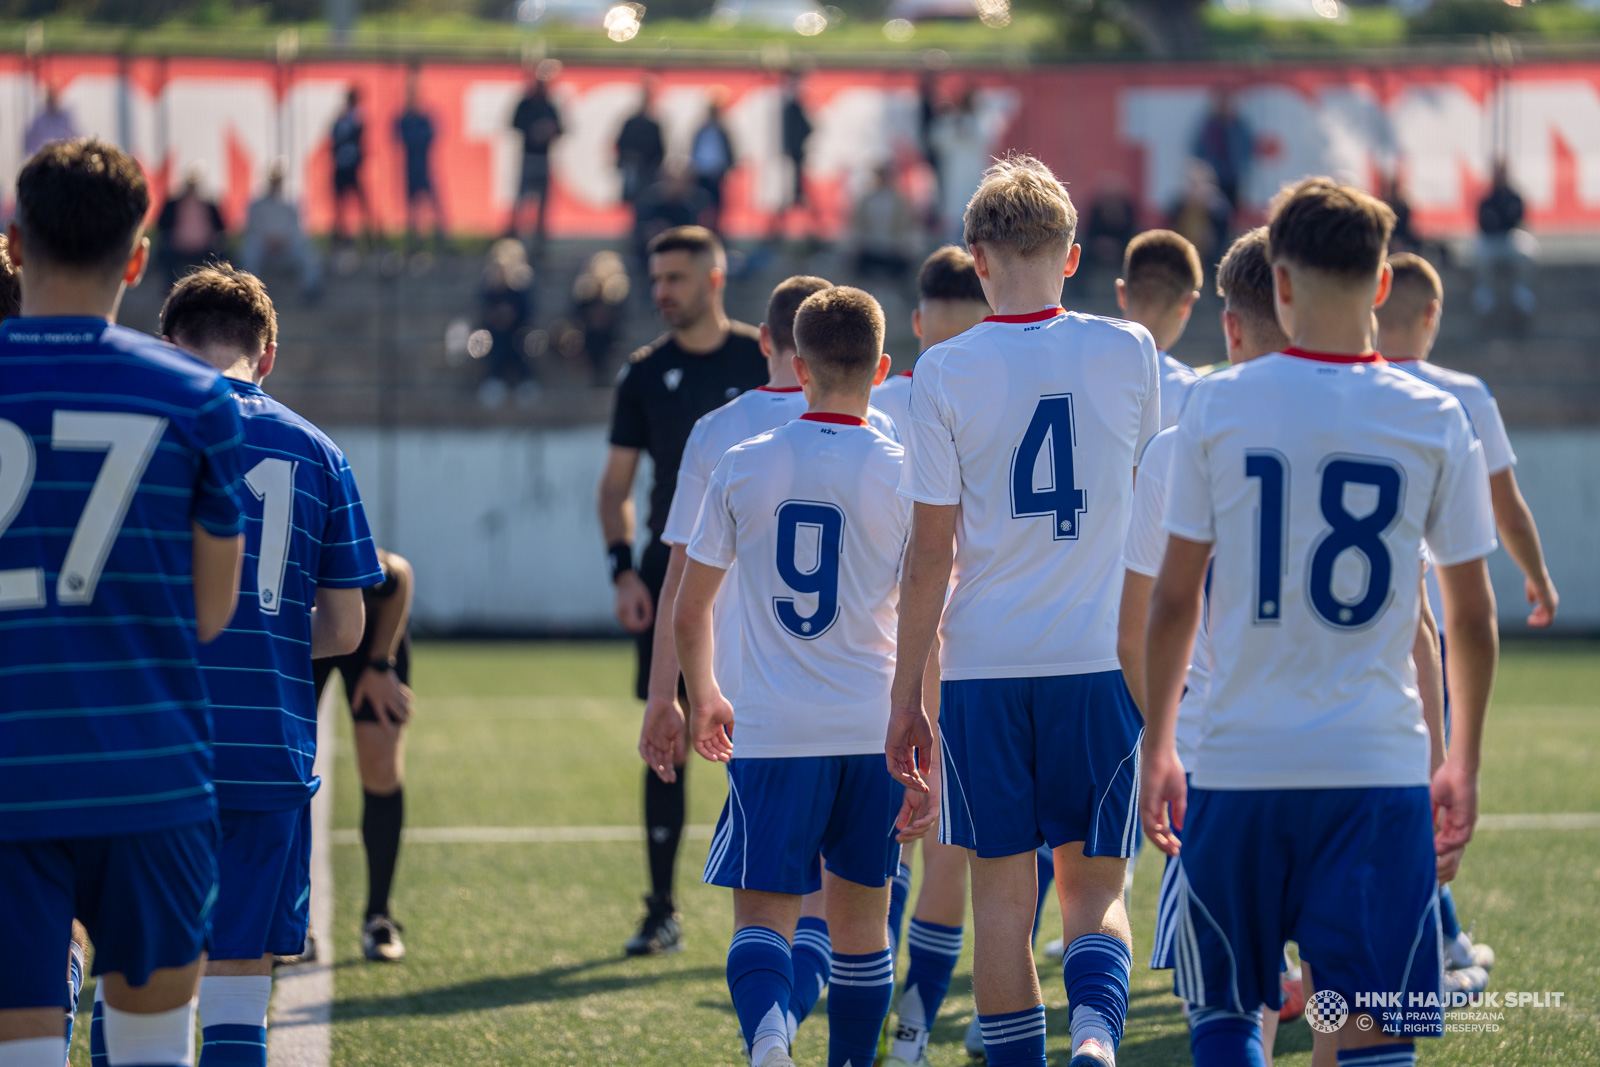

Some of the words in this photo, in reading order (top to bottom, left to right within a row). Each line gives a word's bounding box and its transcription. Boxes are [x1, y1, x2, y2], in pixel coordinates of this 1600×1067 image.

[0, 409, 168, 610] 27
[1010, 393, 1087, 541] 4
[1244, 447, 1408, 633] 18
[772, 498, 846, 640] 9
